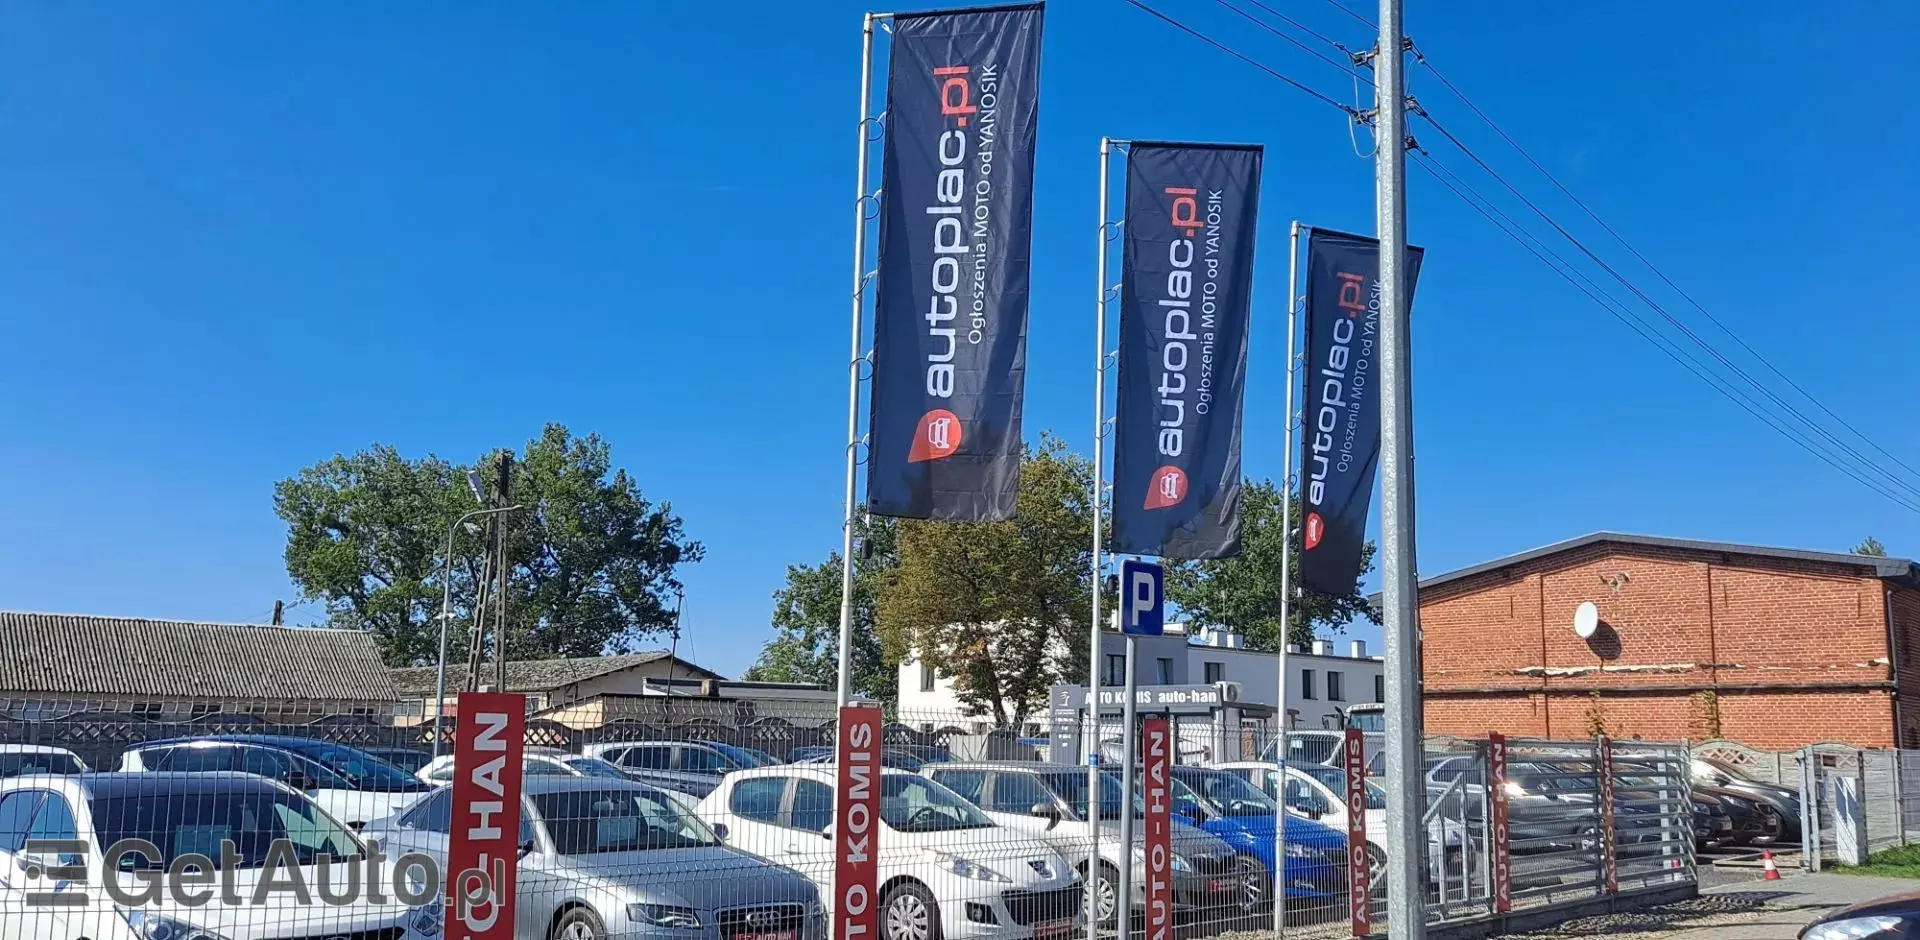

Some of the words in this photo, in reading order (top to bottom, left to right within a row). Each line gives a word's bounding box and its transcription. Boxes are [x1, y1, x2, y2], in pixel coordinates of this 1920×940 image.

[979, 64, 997, 148] YANOSIK
[978, 151, 993, 175] od
[925, 65, 977, 398] autoplac.pl
[974, 180, 991, 237] MOTO
[1205, 189, 1222, 256] YANOSIK
[968, 242, 987, 344] Ogłoszenia
[1201, 282, 1217, 328] MOTO
[1204, 259, 1218, 278] od
[1157, 187, 1204, 457] autoplac.pl
[1196, 332, 1214, 415] Ogłoszenia
[1309, 271, 1366, 506] autoplac.pl
[1336, 402, 1360, 473] Ogłoszenia
[1350, 359, 1369, 400] MOTO
[1360, 338, 1373, 356] od
[1132, 572, 1155, 627] P
[1084, 691, 1111, 704] ATO
[1158, 690, 1217, 703] auto-han
[847, 722, 872, 864] KOMIS
[1350, 738, 1363, 832] KOMIS
[1354, 845, 1366, 924] AUTO
